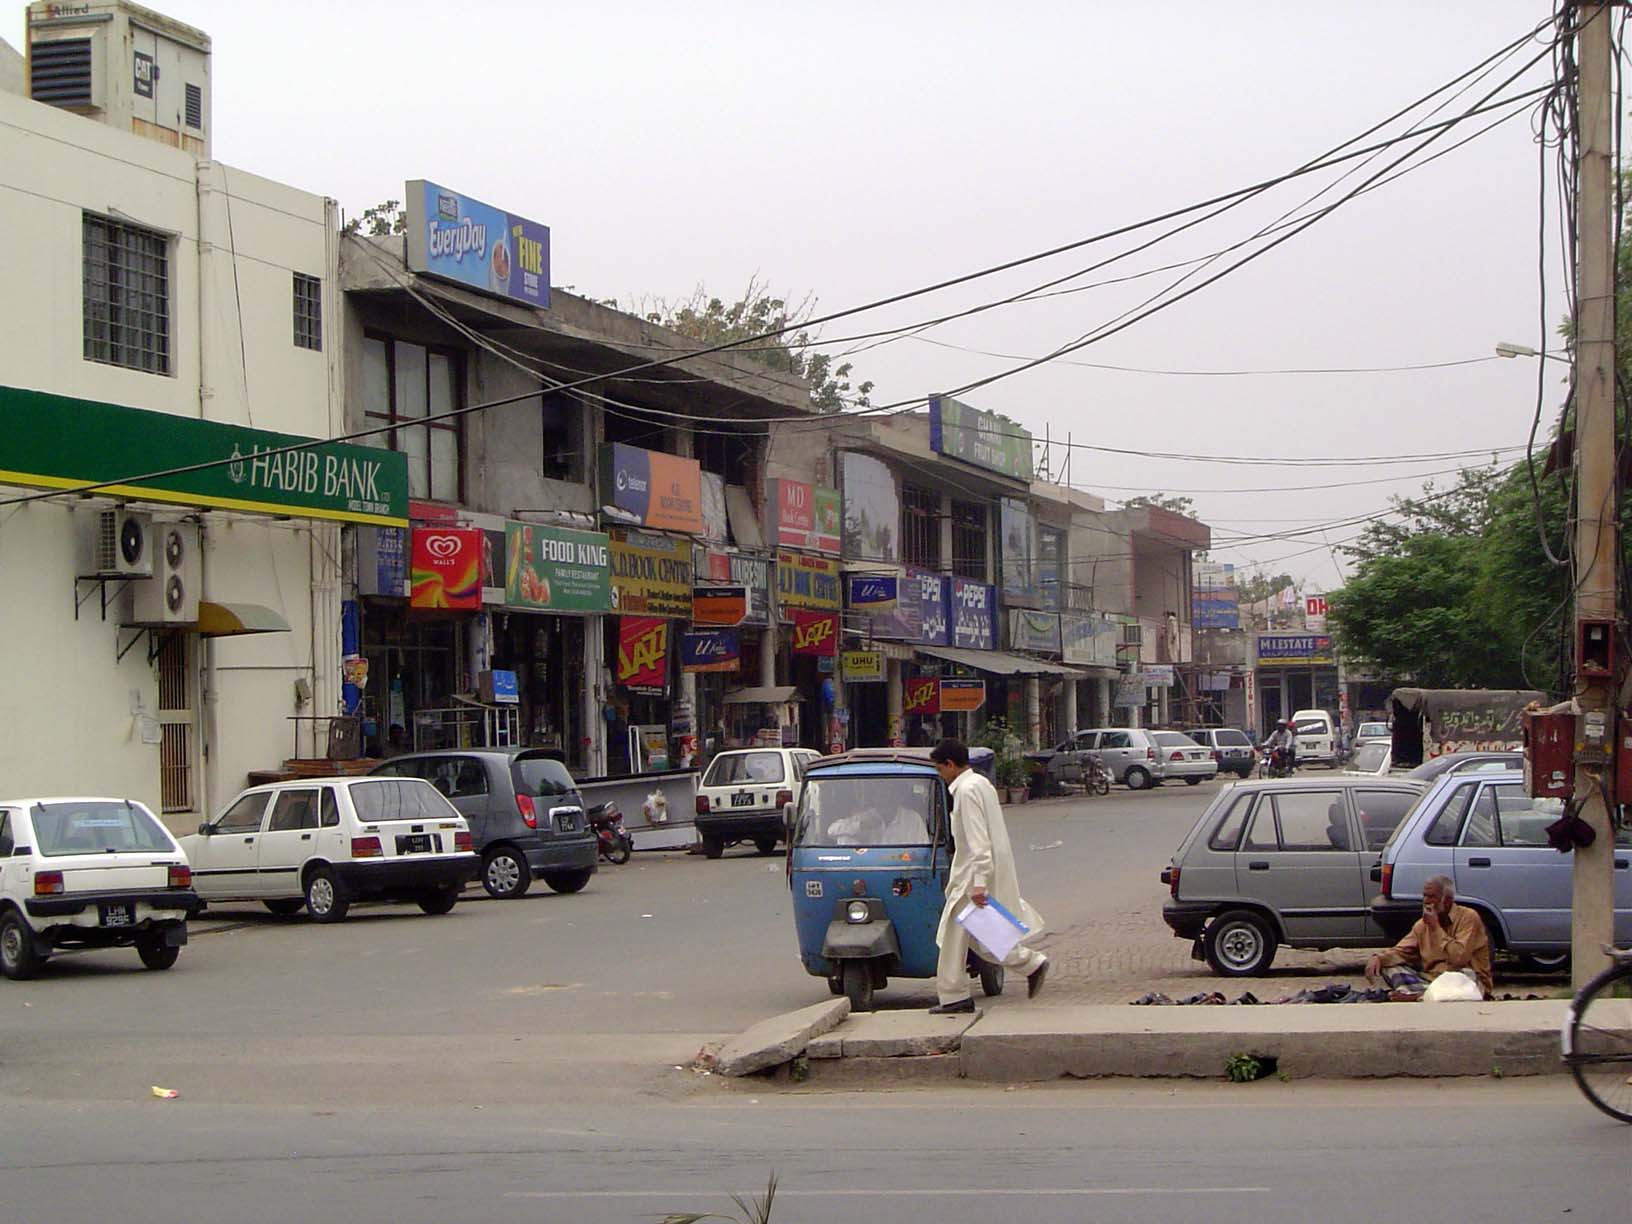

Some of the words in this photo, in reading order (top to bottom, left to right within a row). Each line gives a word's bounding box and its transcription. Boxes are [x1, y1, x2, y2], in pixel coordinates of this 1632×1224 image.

[430, 217, 486, 261] EveryDay
[251, 444, 318, 493] HABIB
[324, 455, 381, 501] BANK
[542, 539, 574, 563] FOOD
[578, 543, 607, 567] KING
[963, 584, 986, 609] PEPSI
[1307, 598, 1329, 615] DH
[852, 657, 873, 665] UHU
